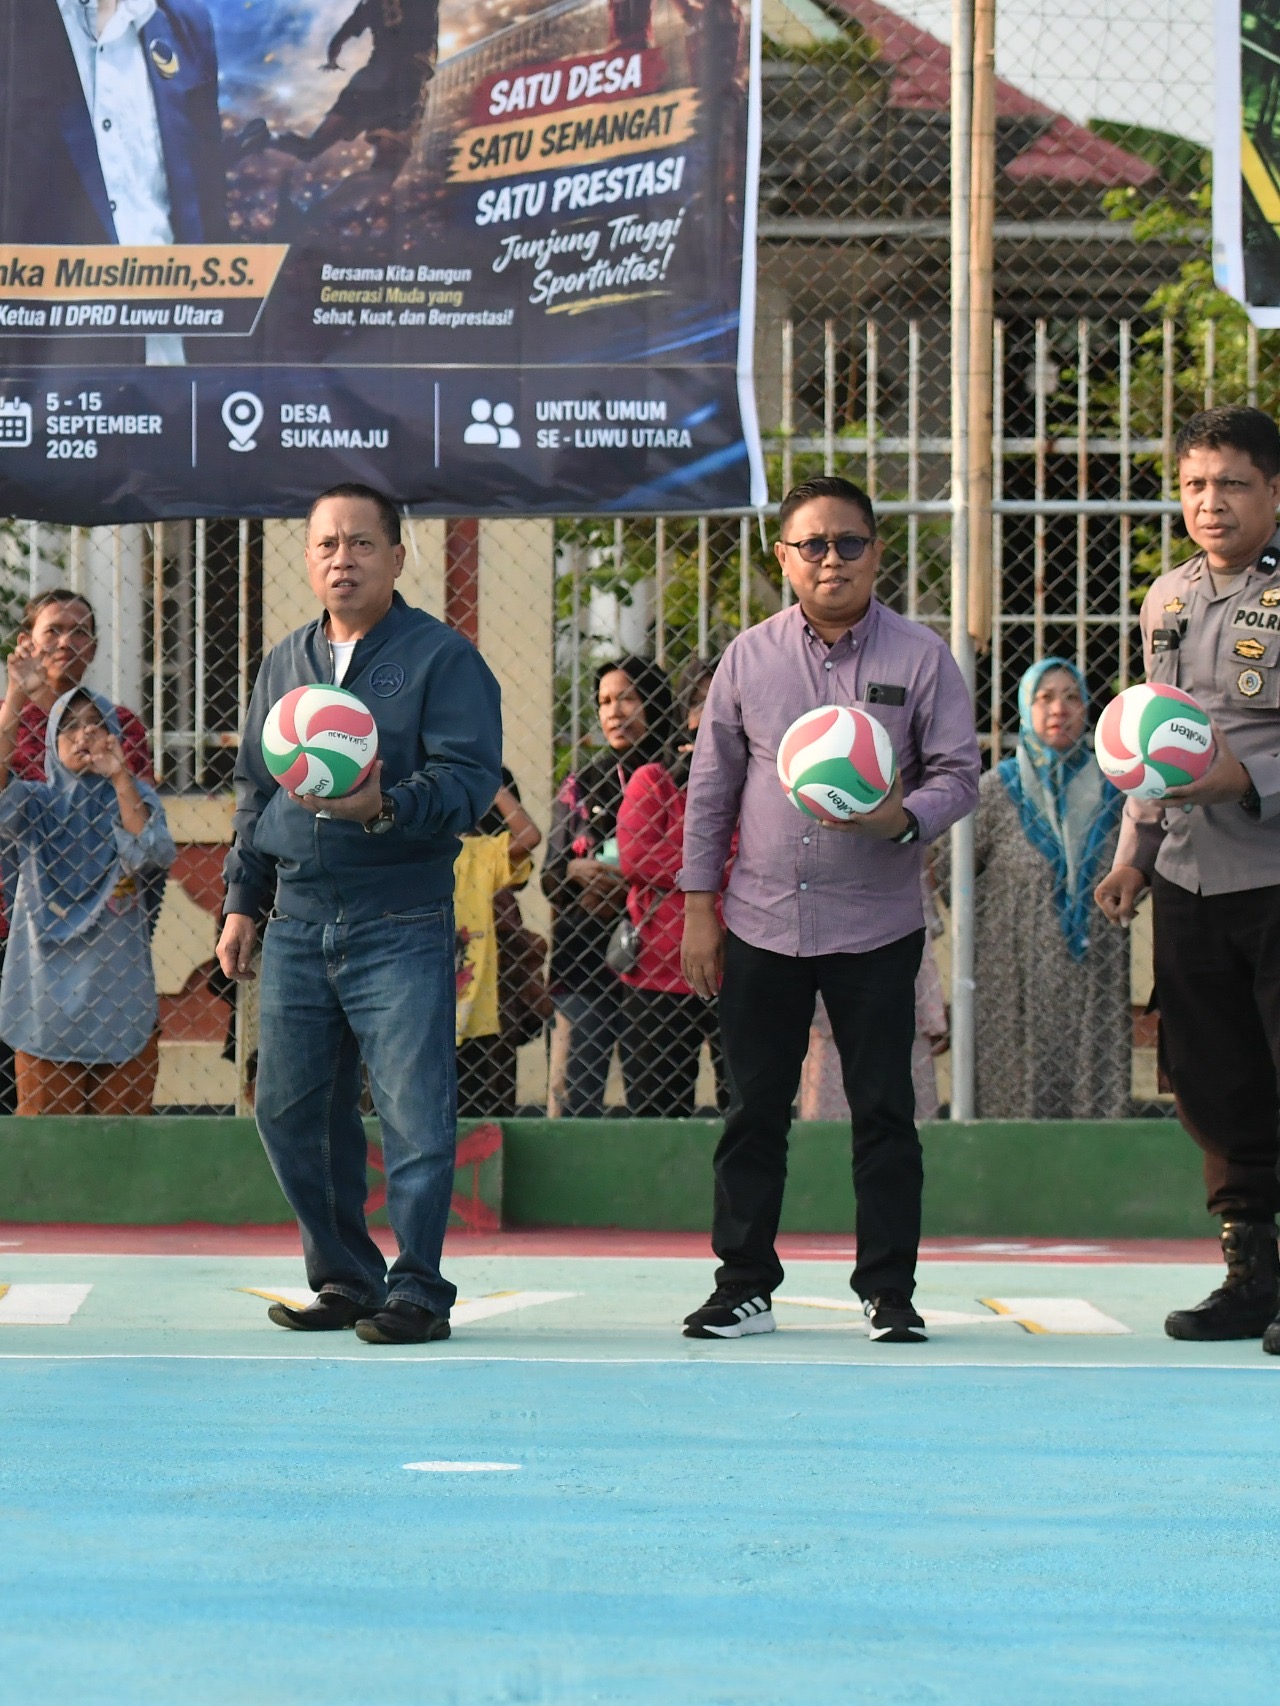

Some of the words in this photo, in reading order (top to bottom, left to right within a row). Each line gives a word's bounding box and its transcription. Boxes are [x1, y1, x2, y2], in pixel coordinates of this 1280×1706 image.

[489, 71, 564, 117] SATU
[566, 54, 642, 101] DESA
[467, 129, 532, 171] SATU
[540, 101, 679, 158] SEMANGAT
[475, 180, 546, 226] SATU
[552, 155, 686, 213] PRESTASI
[491, 226, 599, 274] Junjung
[607, 207, 687, 257] Tinggi
[54, 256, 256, 292] Muslimin,S.S.
[321, 263, 384, 282] Bersama
[385, 264, 415, 282] Kita
[417, 264, 472, 285] Bangun
[528, 243, 676, 305] Sportivitas!
[320, 286, 384, 303] Generasi
[385, 287, 425, 304] Muda
[427, 289, 464, 307] yang
[49, 305, 62, 326] II
[65, 304, 116, 327] DPRD
[119, 305, 170, 327] Luwu
[173, 304, 224, 326] Utara
[313, 307, 357, 326] Sehat,
[359, 308, 397, 327] Kuat,
[398, 308, 426, 325] dan
[428, 308, 515, 329] Berprestasi!
[46, 392, 59, 411] 5
[78, 391, 103, 411] 15
[535, 400, 602, 422] UNTUK
[605, 400, 667, 422] UMUM
[280, 403, 332, 424] DESA
[45, 415, 162, 435] SEPTEMBER
[45, 440, 99, 460] 2026
[280, 429, 389, 450] SUKAMAJU
[535, 429, 561, 449] SE
[575, 429, 629, 449] LUWU
[632, 429, 692, 449] UTARA
[1170, 721, 1208, 747] molten
